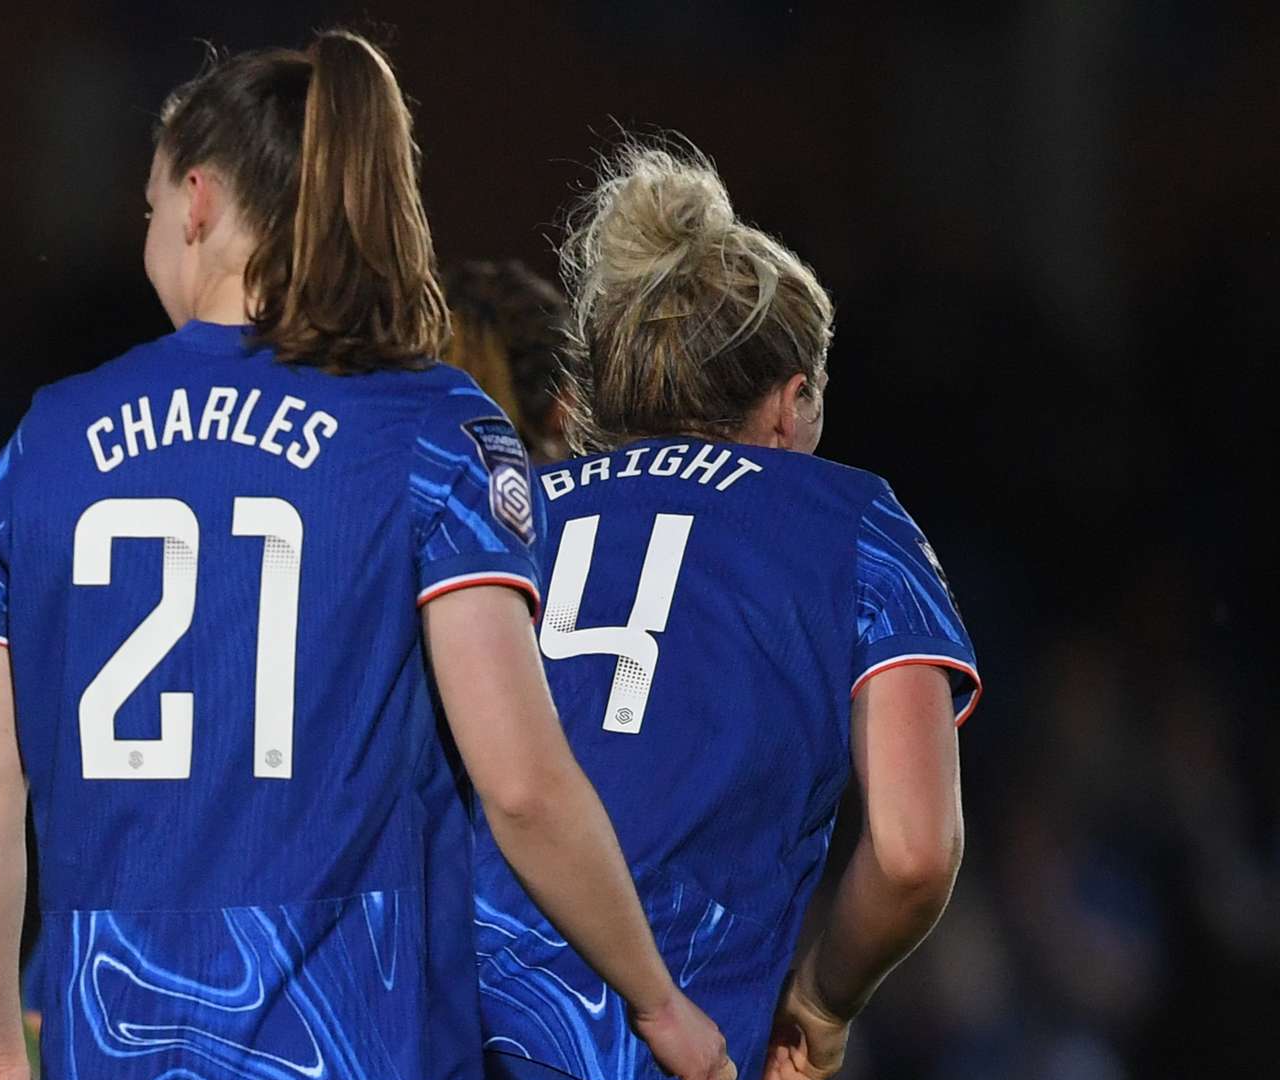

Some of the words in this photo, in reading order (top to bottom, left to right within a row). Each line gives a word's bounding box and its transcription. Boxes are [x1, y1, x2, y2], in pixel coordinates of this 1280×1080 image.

[87, 387, 338, 473] CHARLES
[541, 445, 763, 501] BRIGHT
[74, 497, 304, 780] 21
[538, 514, 695, 735] 4
